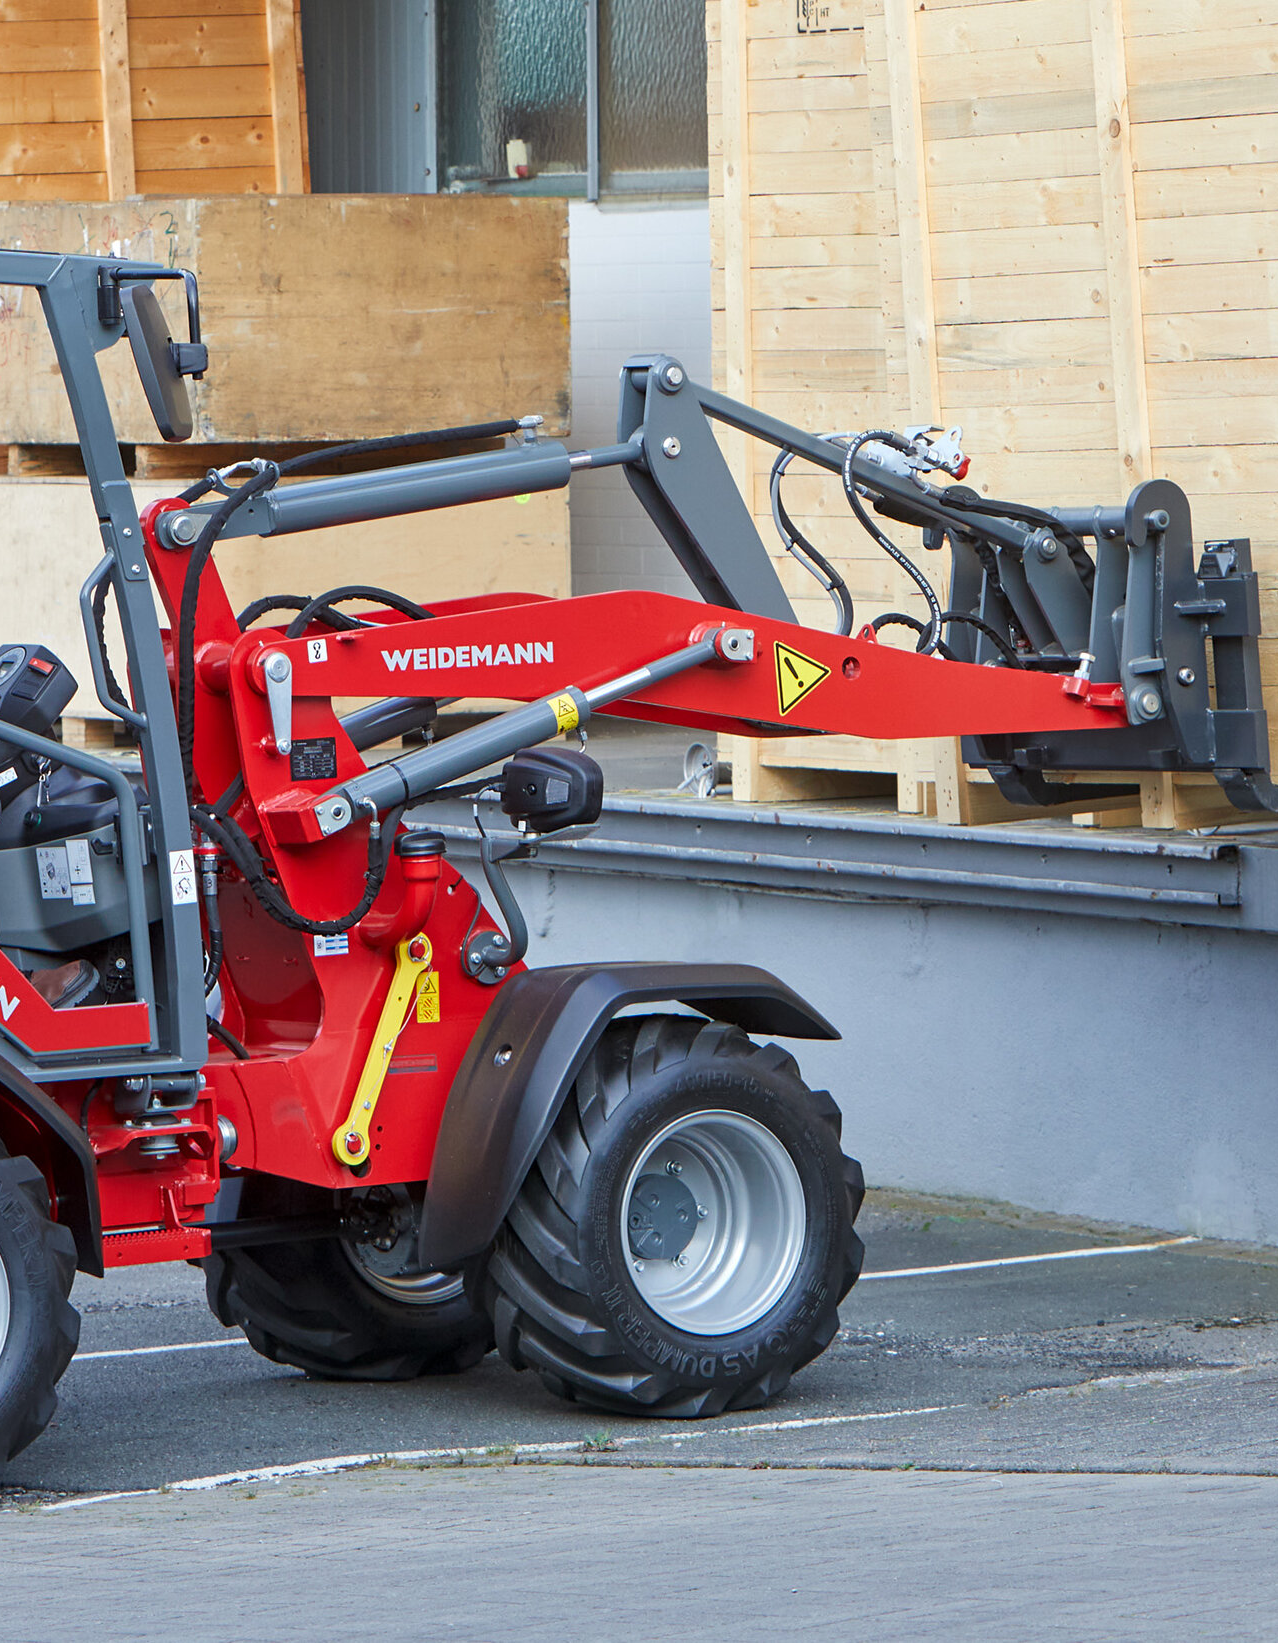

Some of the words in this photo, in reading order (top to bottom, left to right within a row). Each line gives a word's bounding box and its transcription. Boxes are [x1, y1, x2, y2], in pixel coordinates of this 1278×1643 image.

[380, 641, 554, 672] WEIDEMANN
[616, 1304, 717, 1379] DUMPER
[723, 1345, 761, 1378] AS
